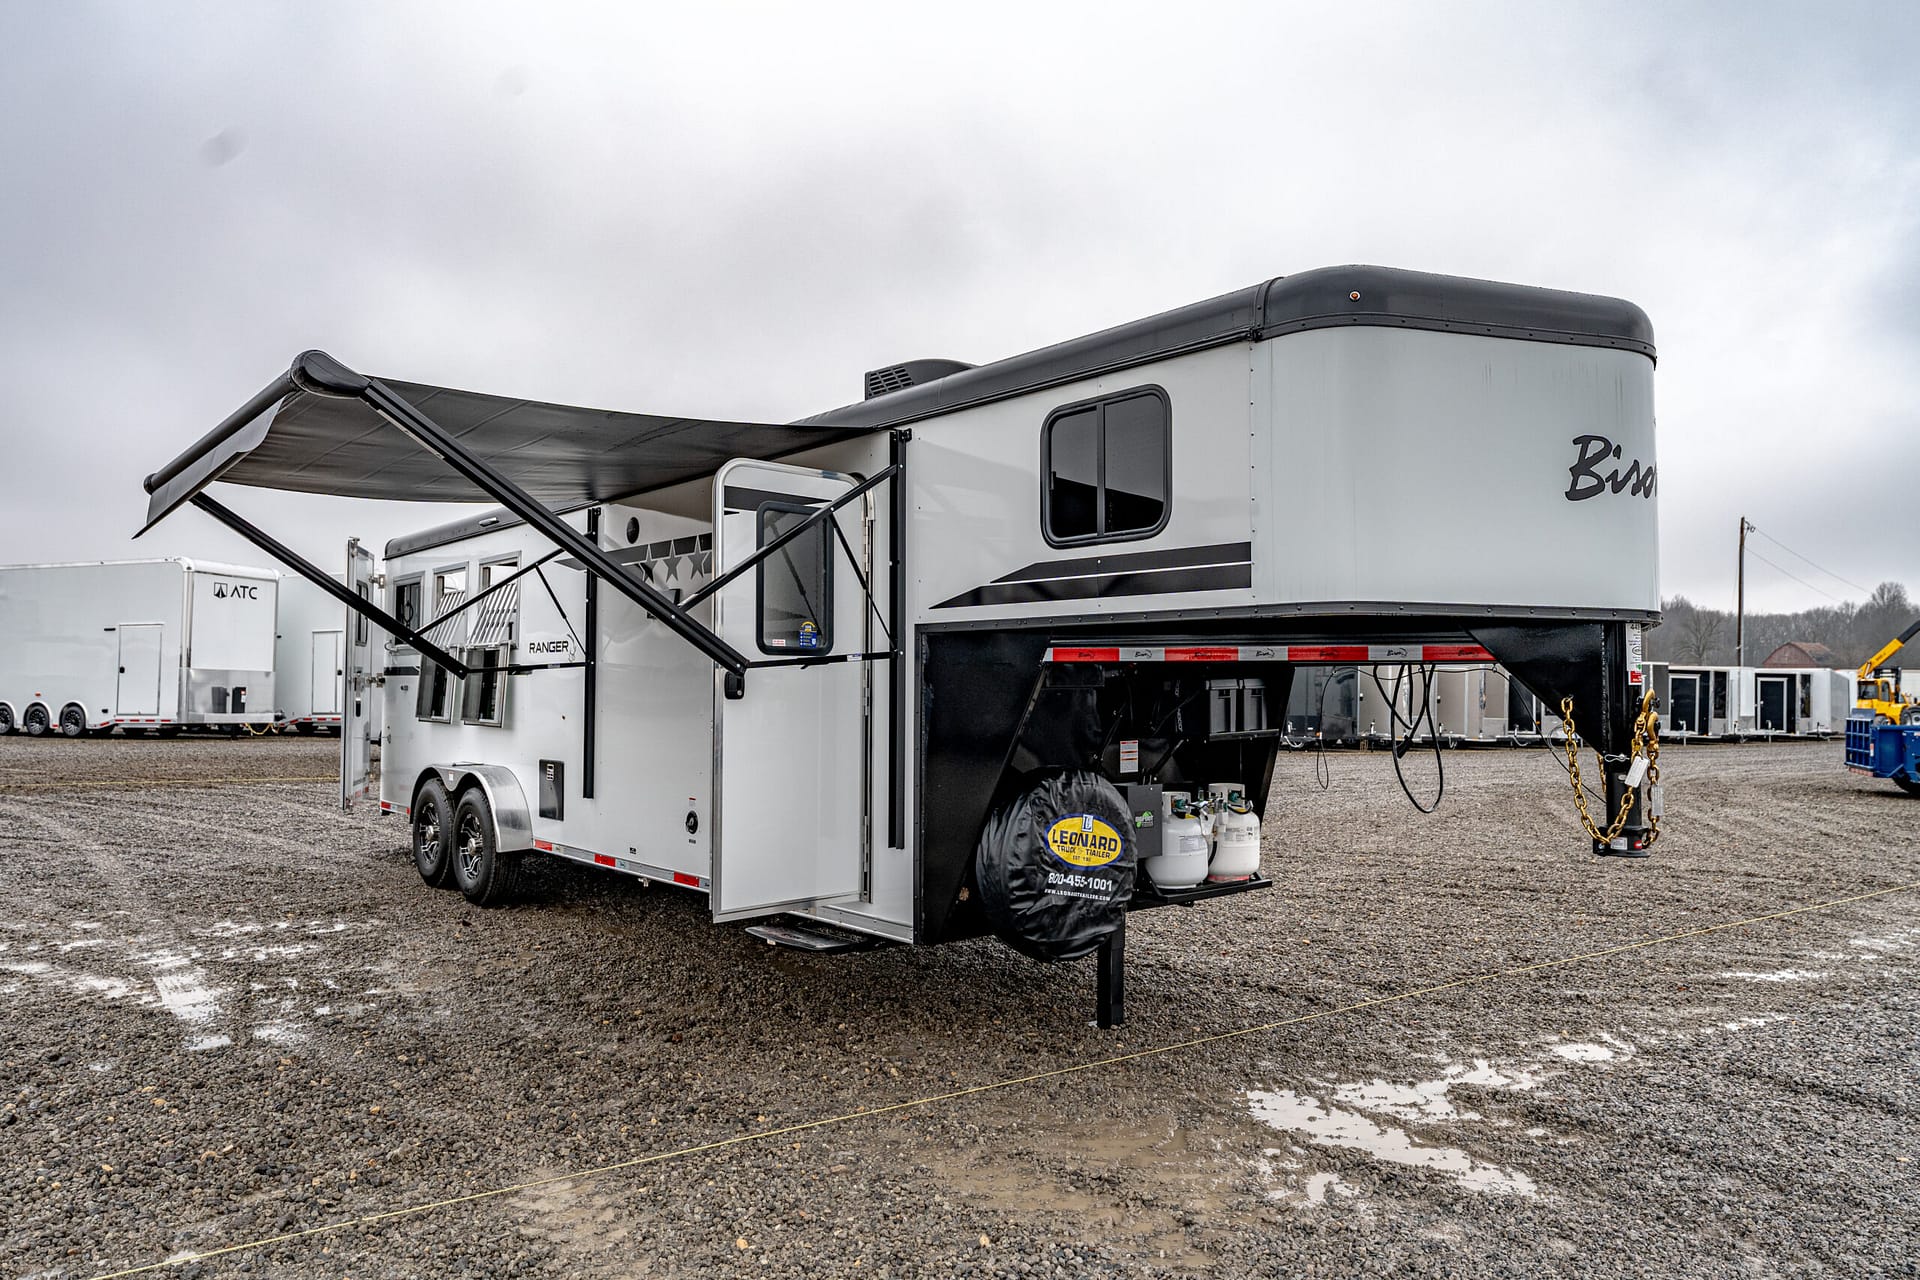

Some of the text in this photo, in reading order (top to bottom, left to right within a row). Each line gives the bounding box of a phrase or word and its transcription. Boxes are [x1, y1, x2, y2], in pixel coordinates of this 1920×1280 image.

[1565, 435, 1657, 501] Biso
[230, 584, 258, 600] ATC
[529, 640, 569, 653] RANGER
[1052, 829, 1118, 852] LEONARD
[1048, 872, 1113, 892] 800-455-1001
